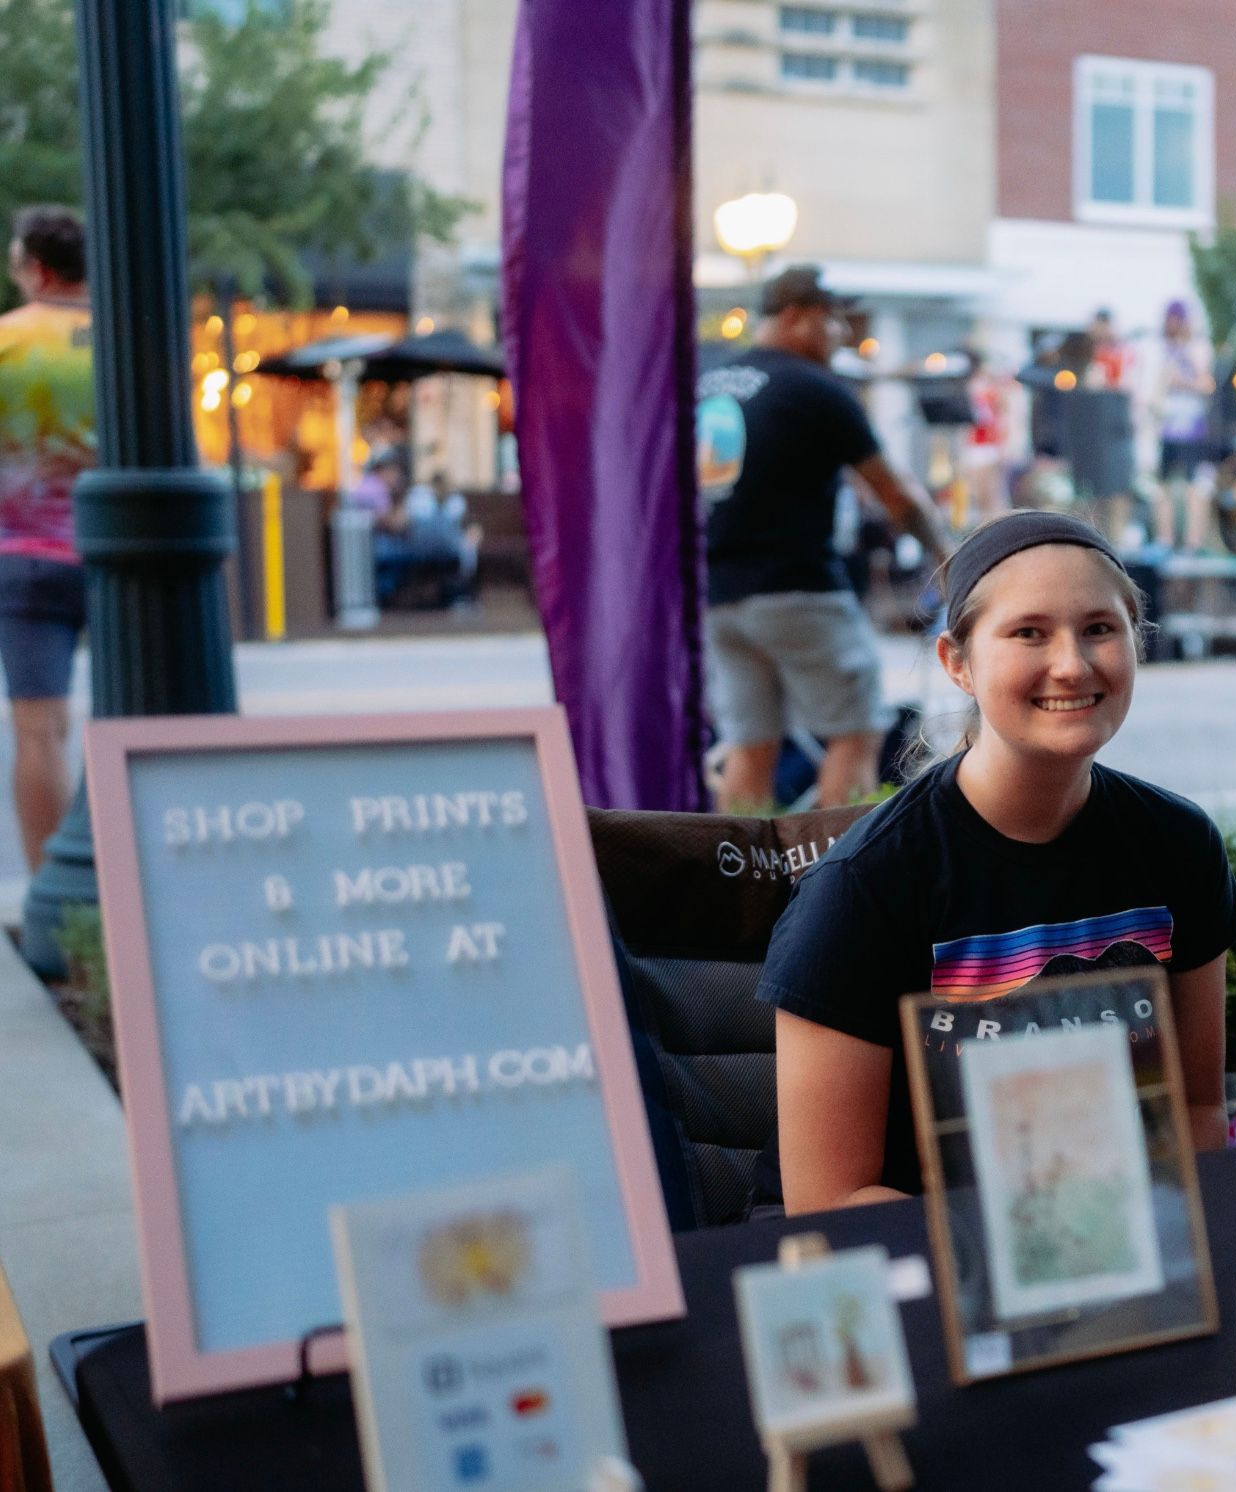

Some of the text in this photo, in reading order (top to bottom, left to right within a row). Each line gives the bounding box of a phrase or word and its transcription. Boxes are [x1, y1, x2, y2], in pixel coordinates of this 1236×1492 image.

[164, 790, 528, 845] SHOP PRINTS
[332, 860, 471, 907] MORE
[199, 921, 505, 982] ONLINE AT
[929, 999, 1154, 1041] BRANSO
